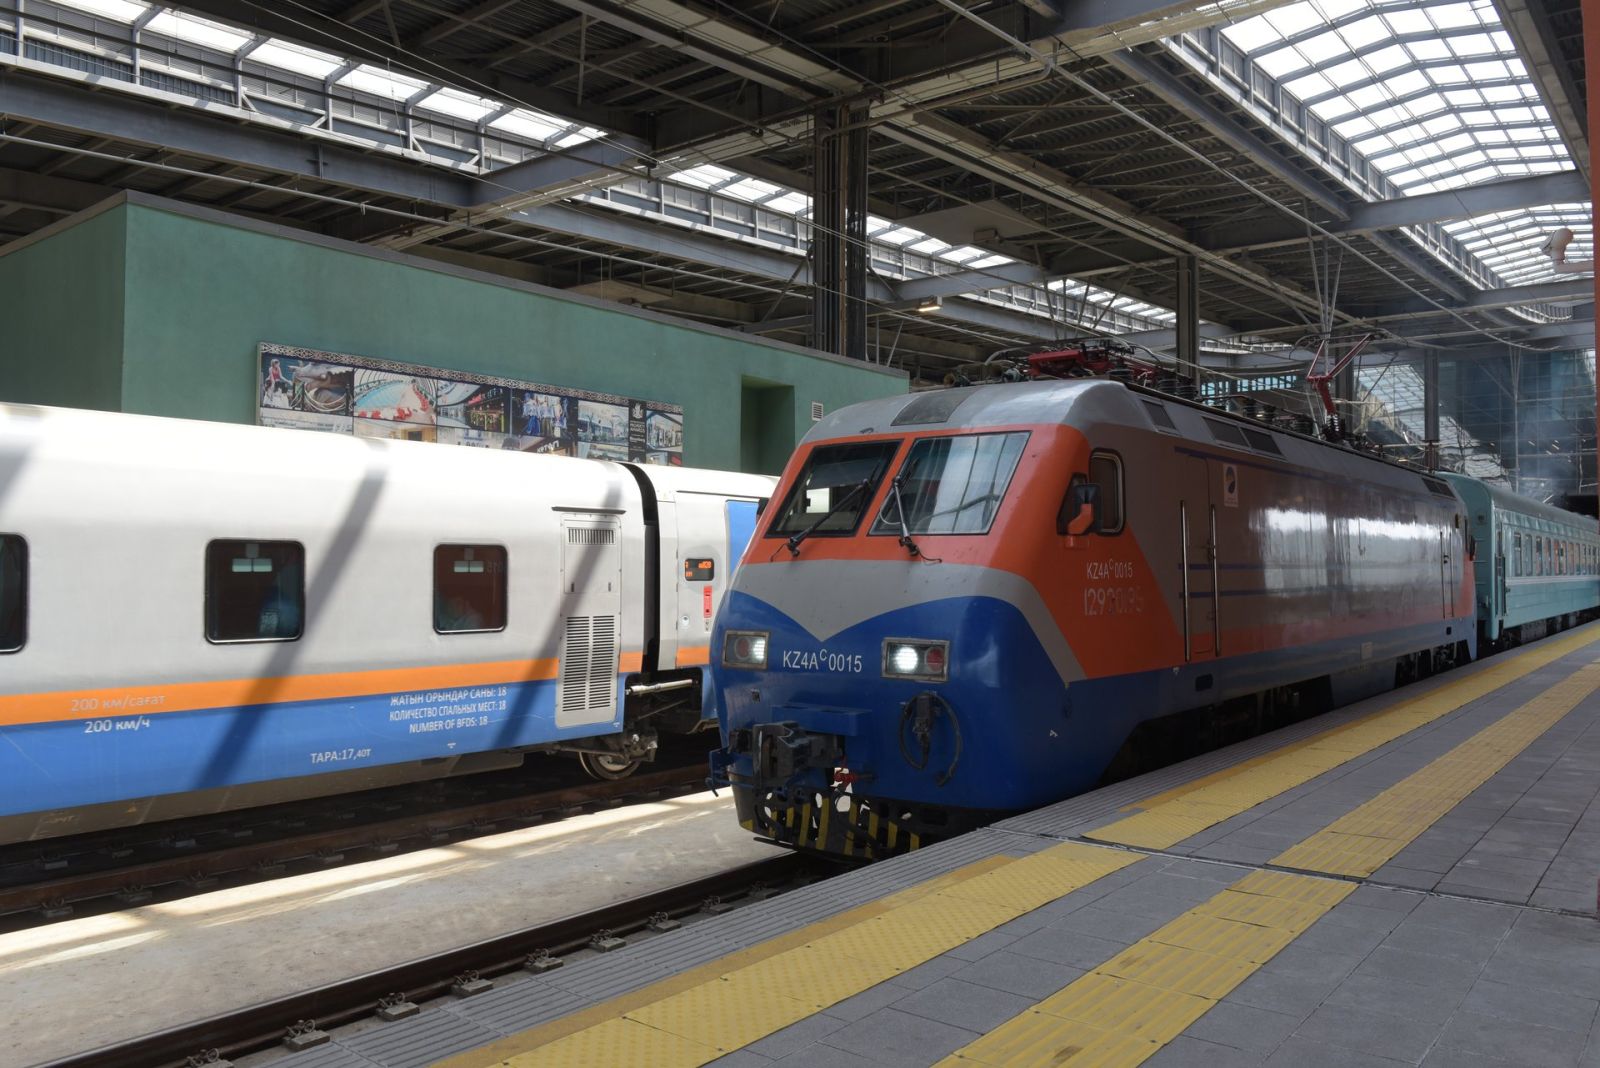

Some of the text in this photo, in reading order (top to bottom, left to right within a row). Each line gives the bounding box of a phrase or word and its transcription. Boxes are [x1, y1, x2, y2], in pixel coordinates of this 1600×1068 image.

[71, 698, 98, 712] 200
[390, 686, 507, 706] ЖАТЫН ОРЫНДАР САНЫ: 18
[389, 699, 507, 721] КОЛИЧЕСТВО СПАЛЬНЫХ МЕСТ: 18
[84, 715, 151, 734] 200 км/ч
[409, 721, 444, 734] NUMBER
[444, 719, 456, 730] OF
[479, 715, 488, 727] 18
